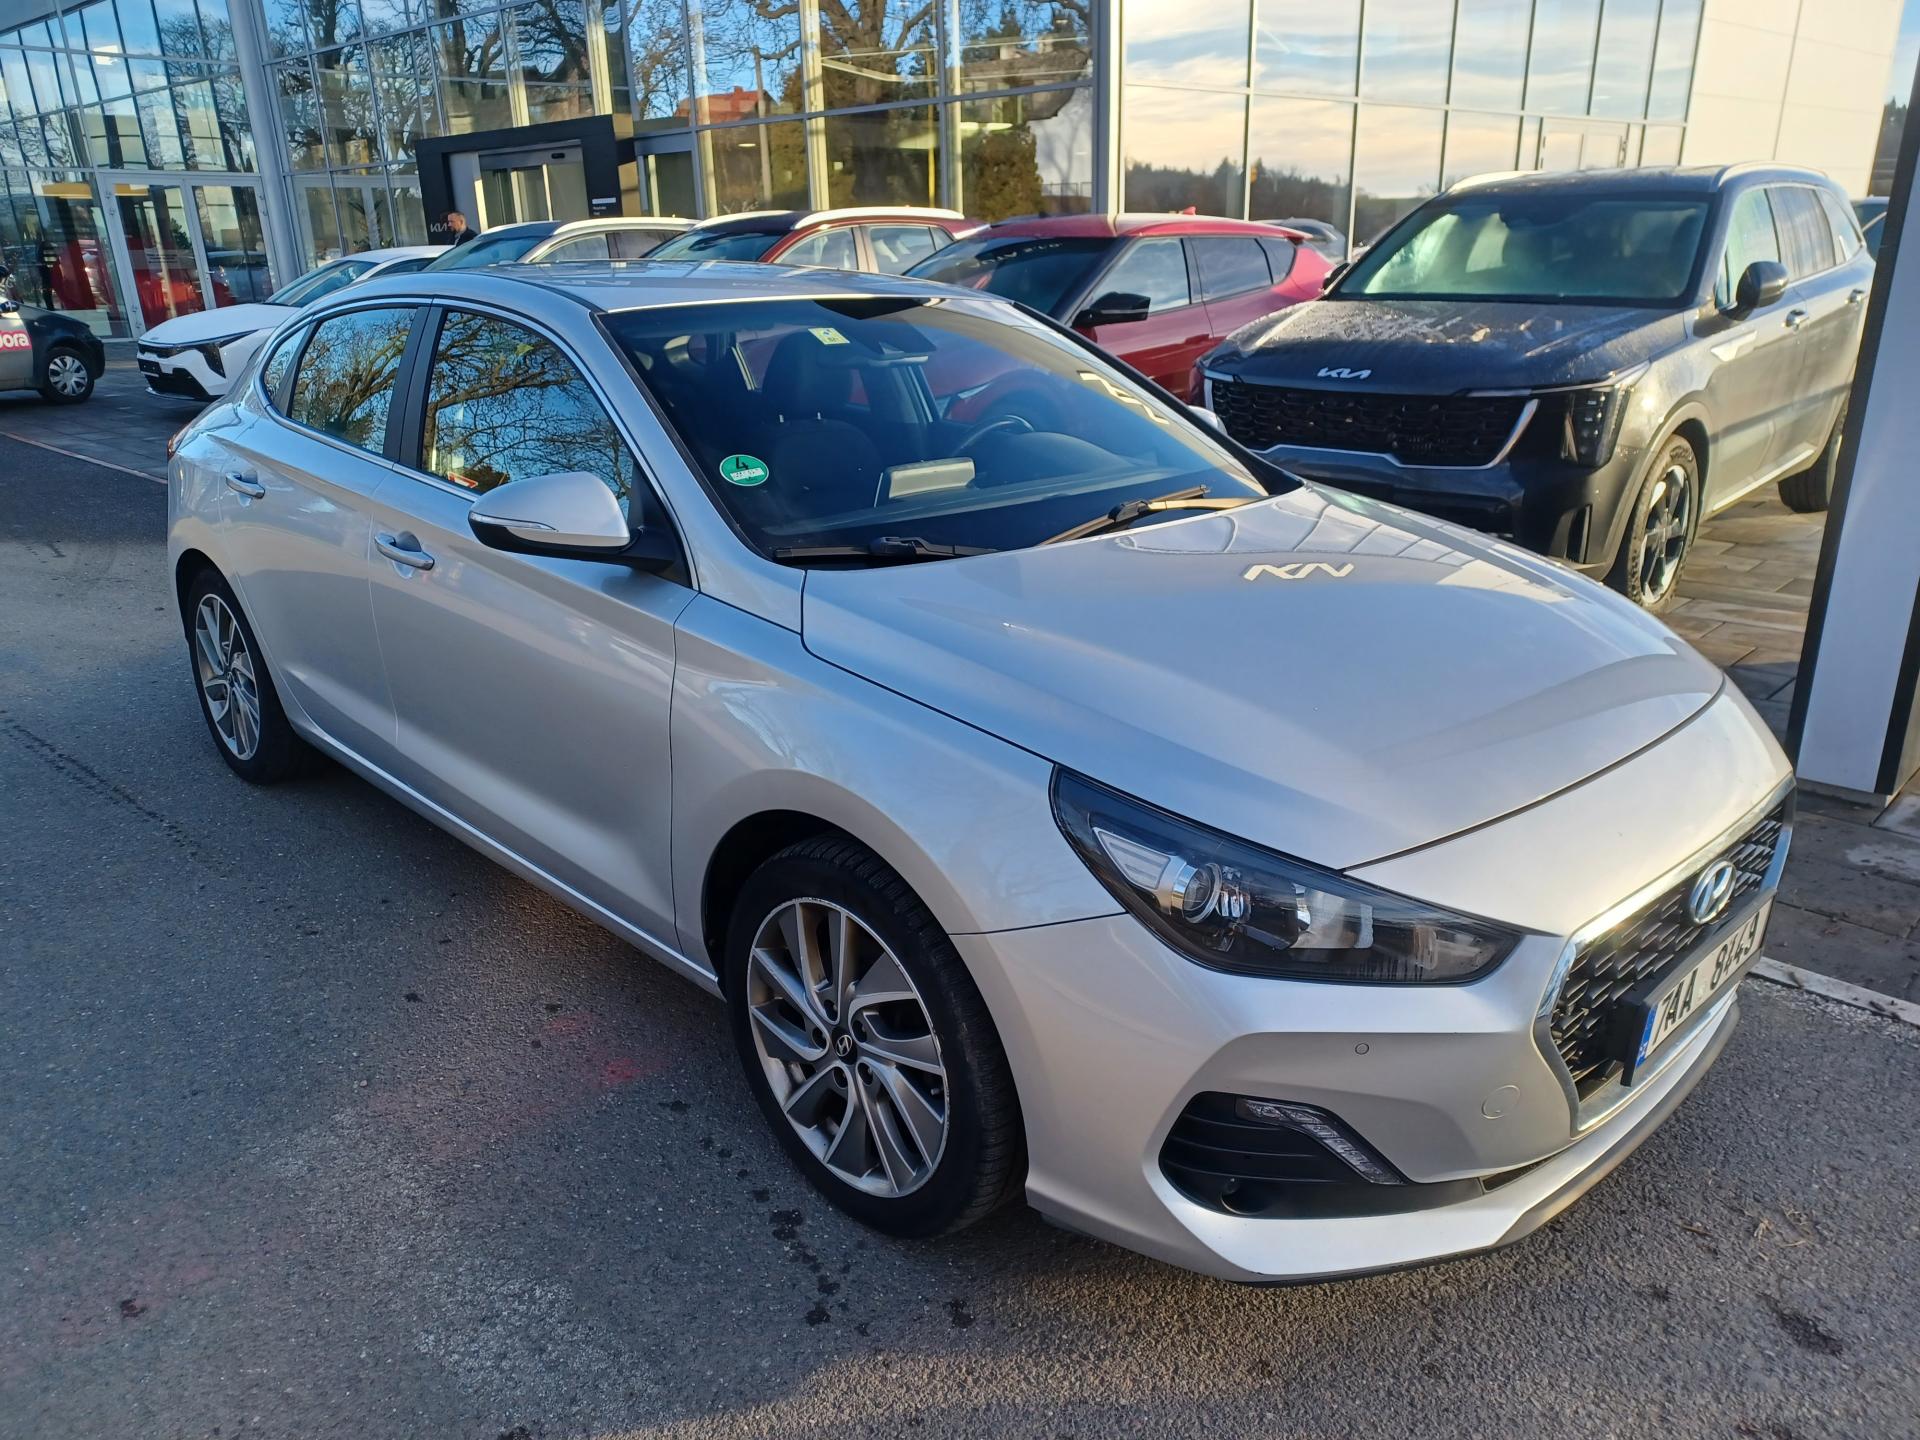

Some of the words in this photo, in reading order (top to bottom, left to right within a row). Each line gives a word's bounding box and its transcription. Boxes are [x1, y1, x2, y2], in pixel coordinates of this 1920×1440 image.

[1317, 367, 1372, 379] KIA
[735, 456, 748, 469] 4
[1653, 968, 1699, 1046] 7AA
[1710, 911, 1760, 990] 8449
